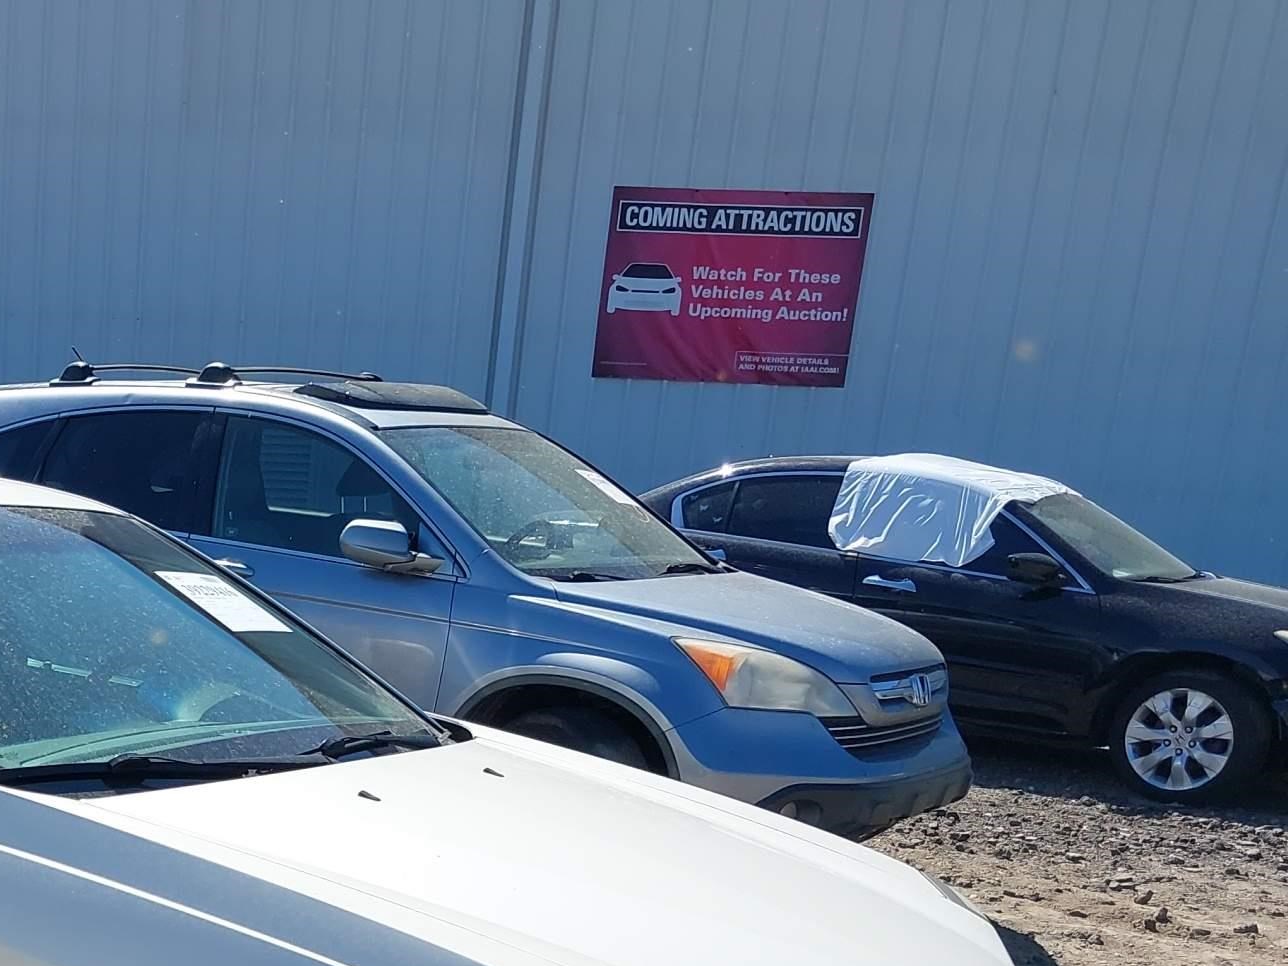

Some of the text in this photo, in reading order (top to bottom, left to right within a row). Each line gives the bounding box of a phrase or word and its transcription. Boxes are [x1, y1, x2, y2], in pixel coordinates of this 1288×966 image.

[625, 205, 857, 233] COMING ATTRACTIONS
[692, 266, 841, 284] Watch For These
[691, 284, 823, 302] Vehicles At An
[688, 303, 849, 322] Upcoming Auction!
[739, 355, 830, 366] VIEW VEHICLE DETAILS
[757, 364, 788, 373] PHOTOS
